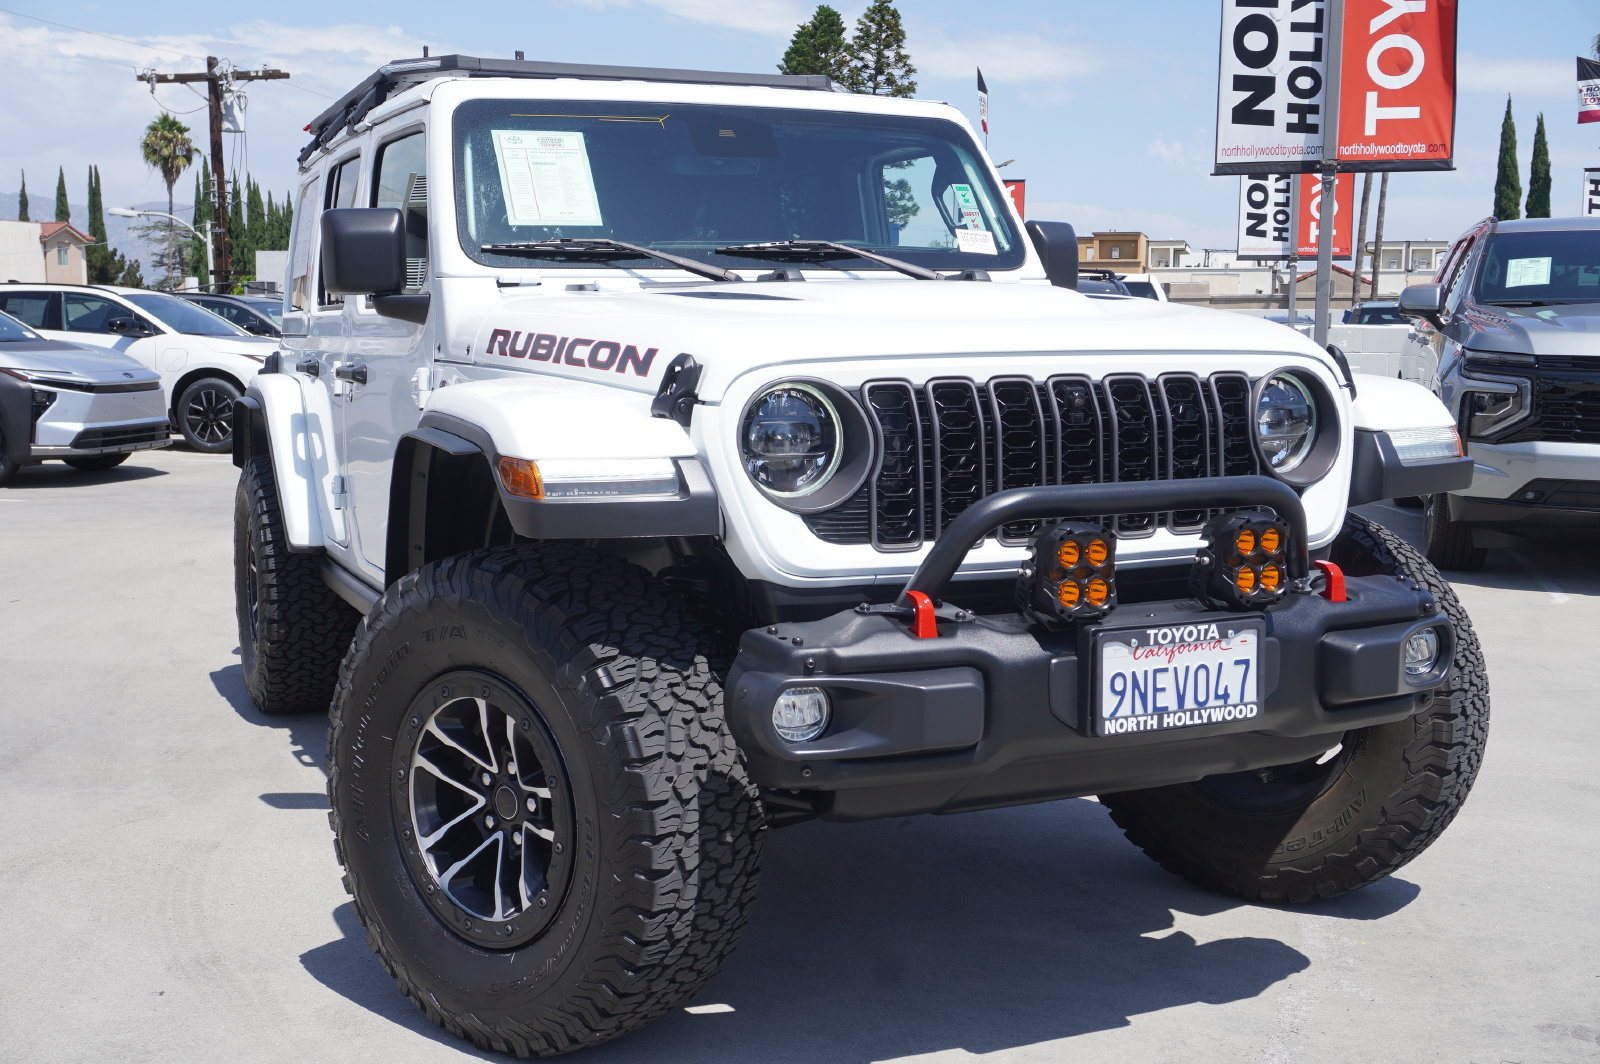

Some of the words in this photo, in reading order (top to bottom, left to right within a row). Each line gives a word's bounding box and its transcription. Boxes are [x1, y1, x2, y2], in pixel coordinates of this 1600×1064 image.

[1232, 0, 1279, 126] NO
[1221, 144, 1323, 159] northhollywoodtoyota.com
[1340, 142, 1446, 157] northhollywoodtoyota.com
[1246, 174, 1269, 238] NO
[486, 328, 660, 377] RUBICON
[1147, 624, 1219, 645] TOYOTA
[1133, 639, 1232, 664] California
[1109, 658, 1251, 718] 9NEV047
[1104, 715, 1158, 735] NORTH
[1163, 704, 1258, 728] HOLLYWOOD
